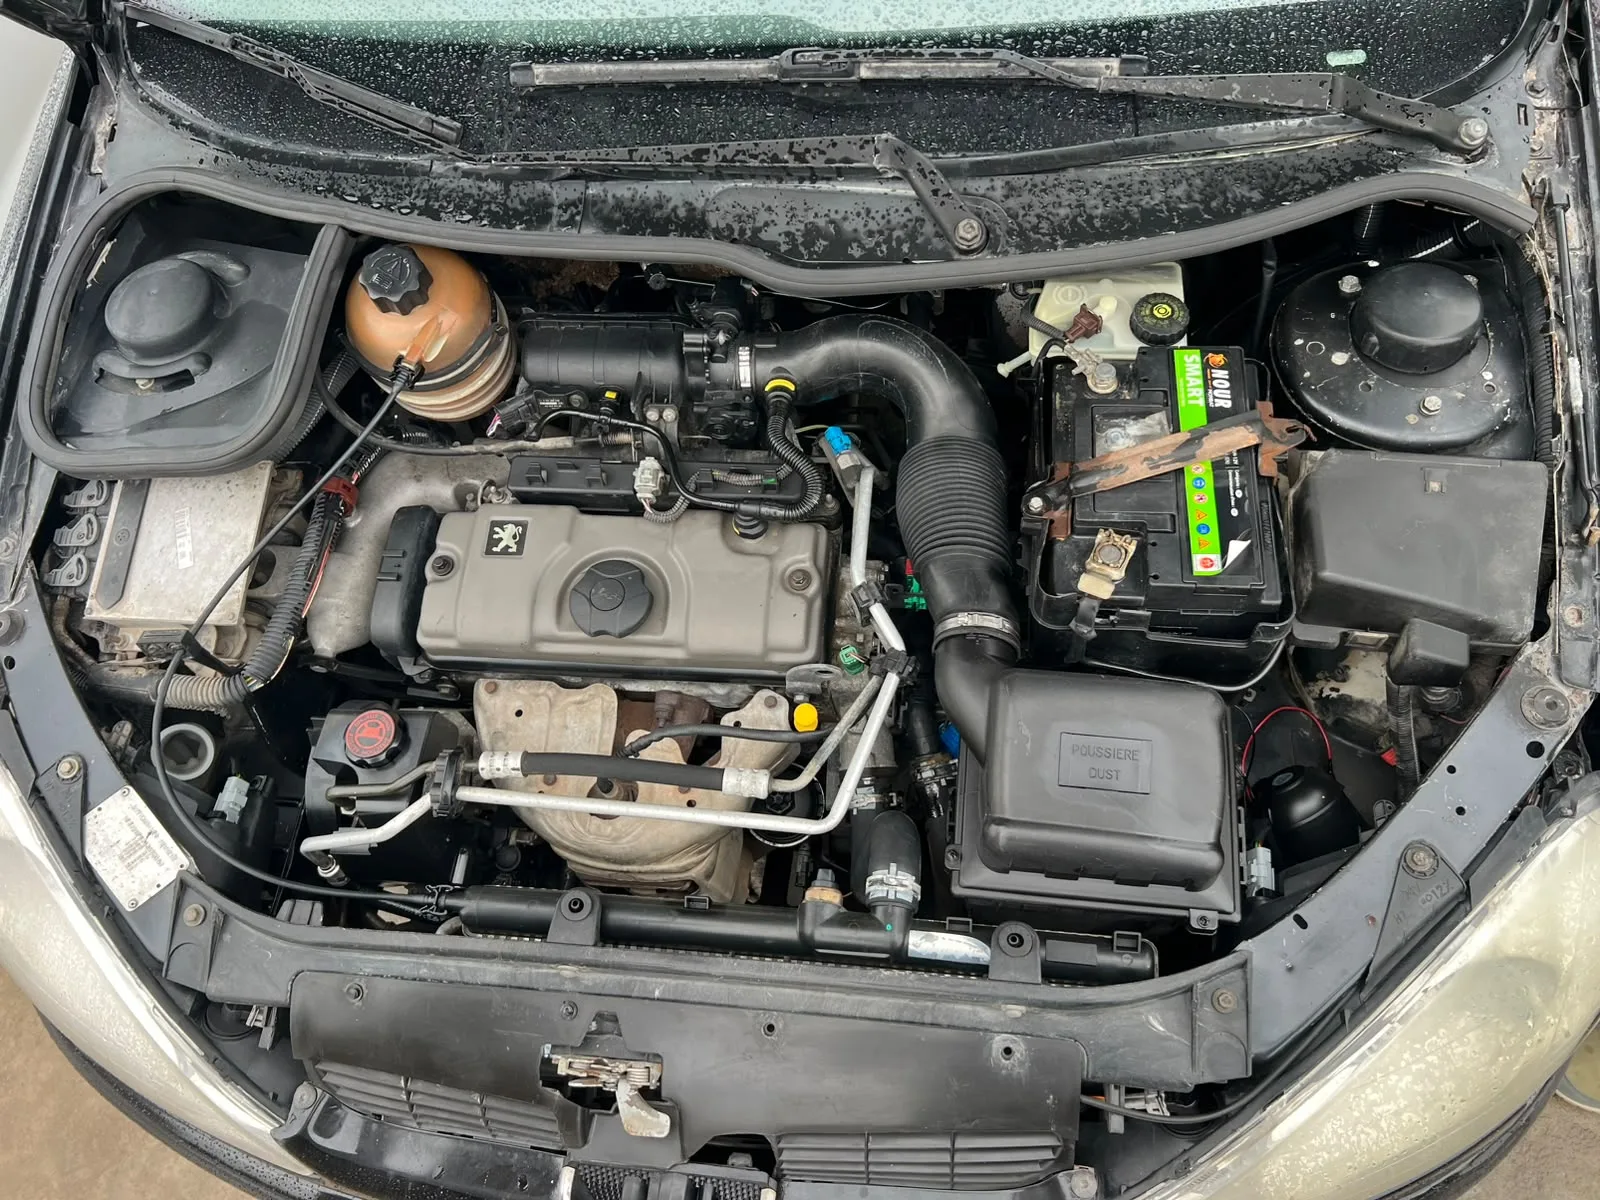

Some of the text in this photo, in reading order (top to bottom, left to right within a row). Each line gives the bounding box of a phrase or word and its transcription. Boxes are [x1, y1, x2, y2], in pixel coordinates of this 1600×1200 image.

[1184, 354, 1204, 408] SMART
[1211, 368, 1232, 408] NOUR
[1072, 743, 1140, 761] POUSSIERE
[1089, 766, 1121, 781] DUST
